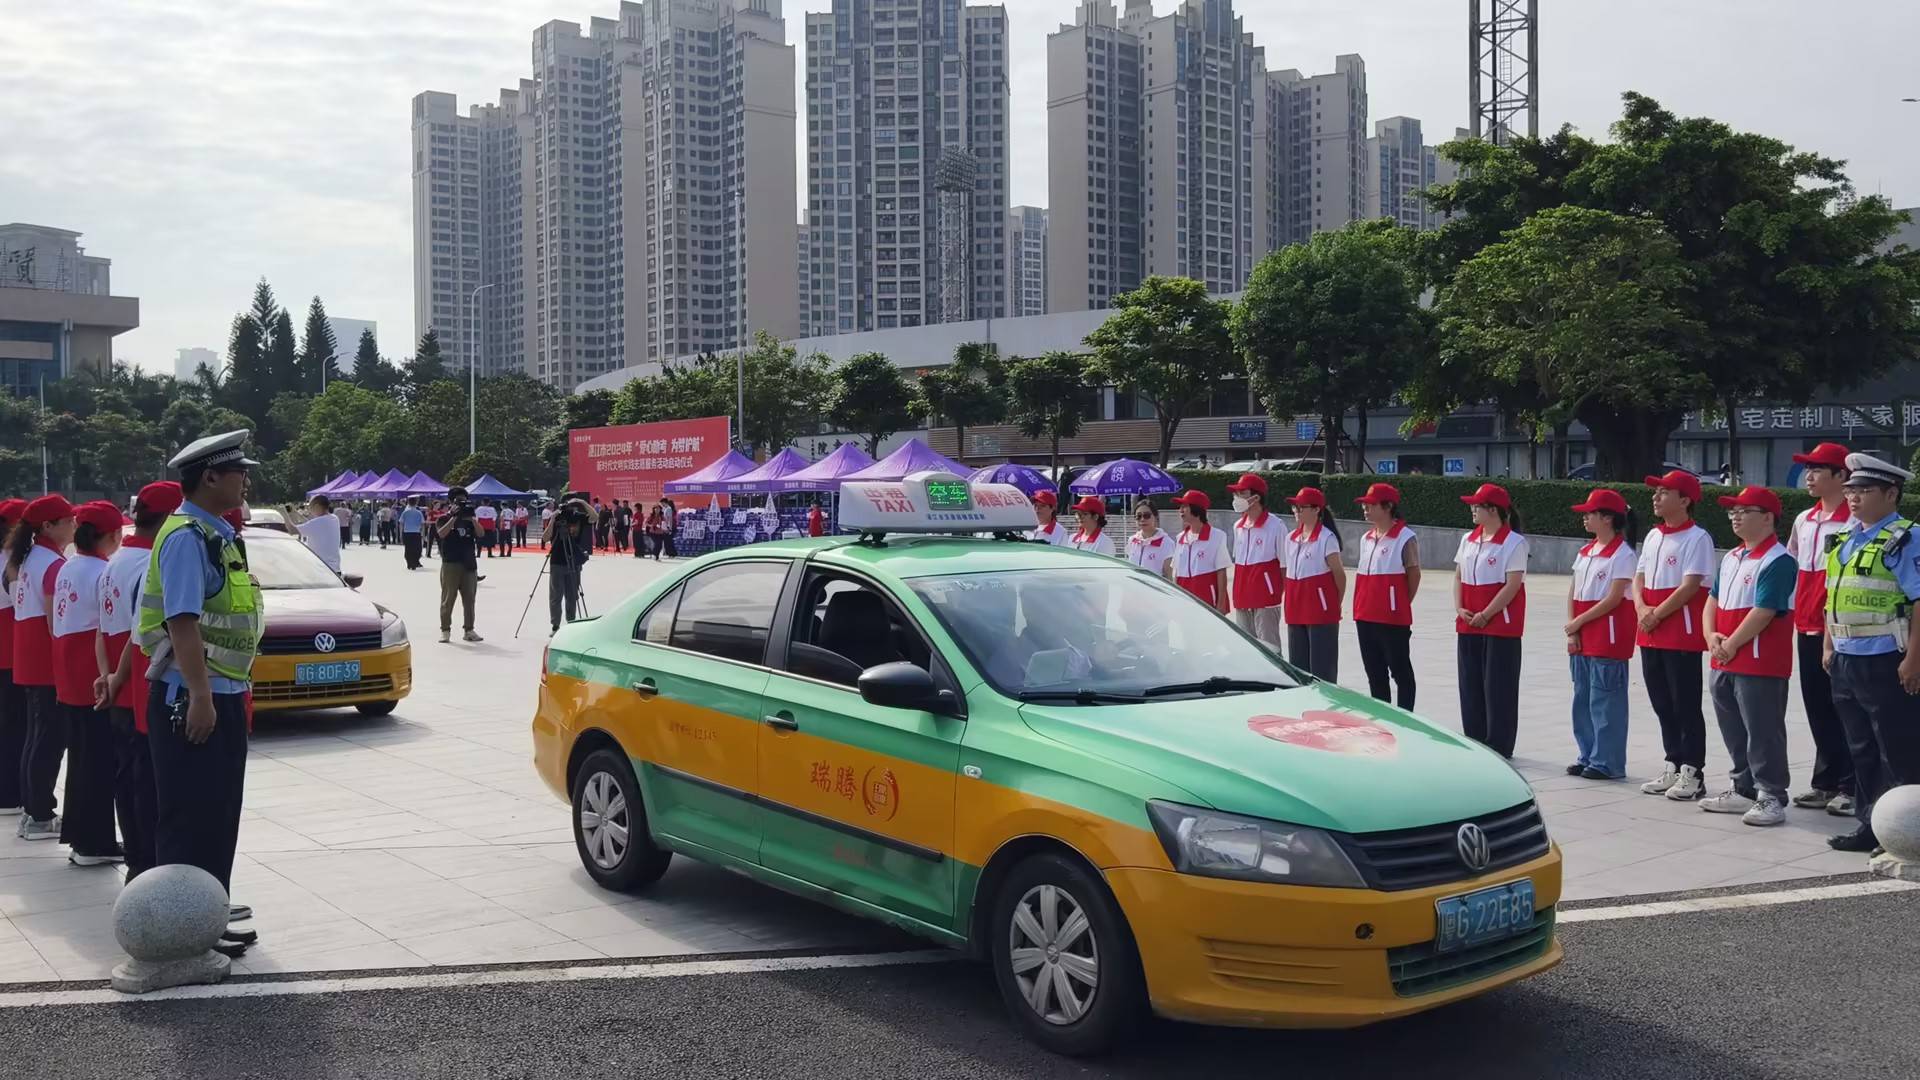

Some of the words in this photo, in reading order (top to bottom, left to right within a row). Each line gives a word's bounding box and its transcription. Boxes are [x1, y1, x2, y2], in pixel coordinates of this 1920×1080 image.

[864, 488, 907, 499] 出租
[871, 500, 916, 512] TAXI
[1844, 595, 1887, 608] POLICE
[810, 759, 857, 801] 瑞腾
